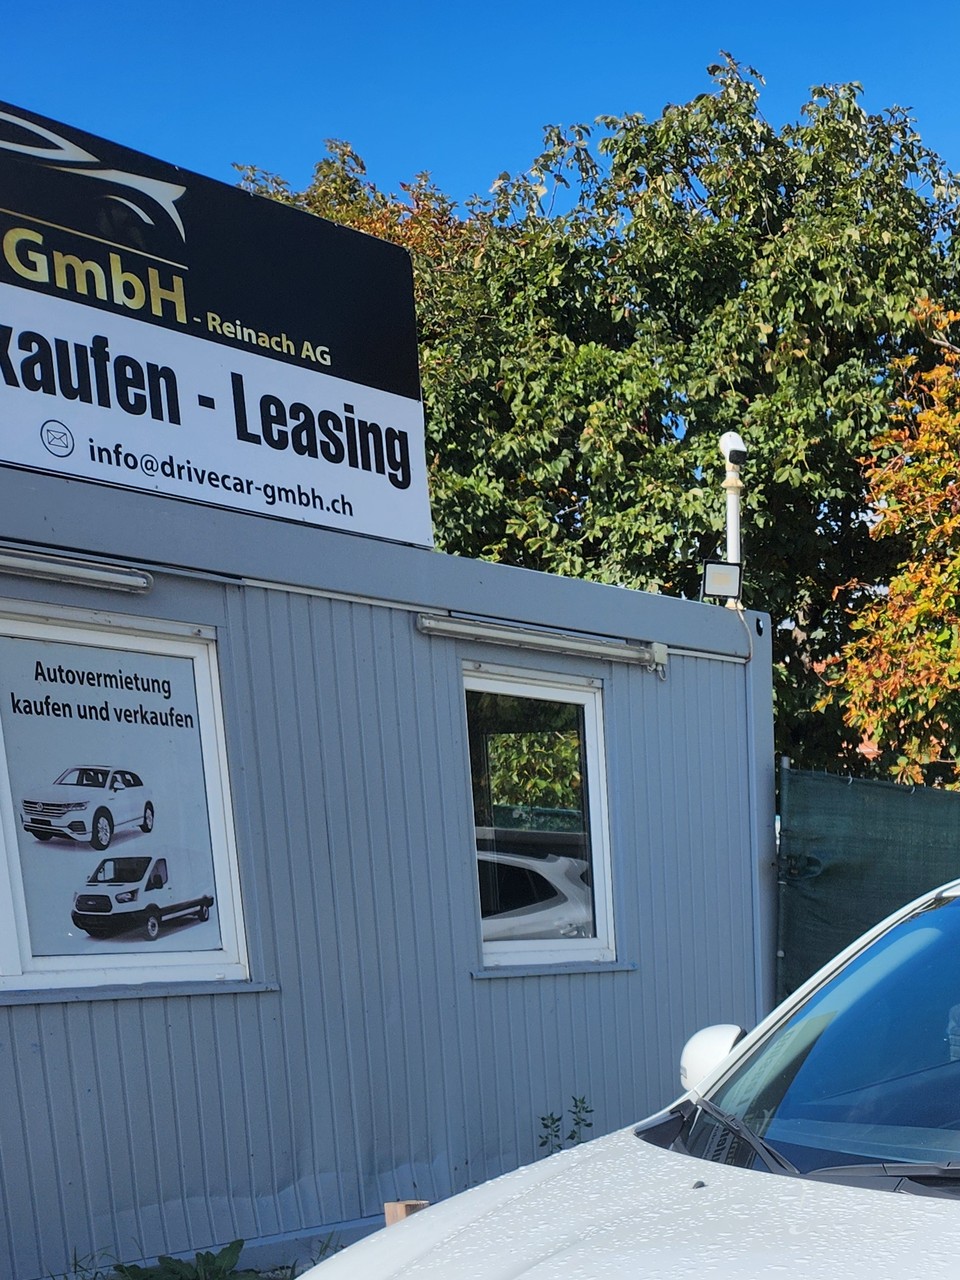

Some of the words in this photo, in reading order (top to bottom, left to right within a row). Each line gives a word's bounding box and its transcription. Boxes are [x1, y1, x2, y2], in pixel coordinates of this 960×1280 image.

[3, 227, 187, 325] GmbH
[207, 311, 295, 356] Reinach
[301, 341, 332, 366] AG
[231, 371, 412, 490] Leasing
[88, 438, 354, 517] info@drivecar-gmbh.ch
[10, 692, 73, 718] kaufen
[77, 701, 110, 722] und
[114, 706, 194, 728] verkaufen
[34, 660, 171, 699] Autovermietung
